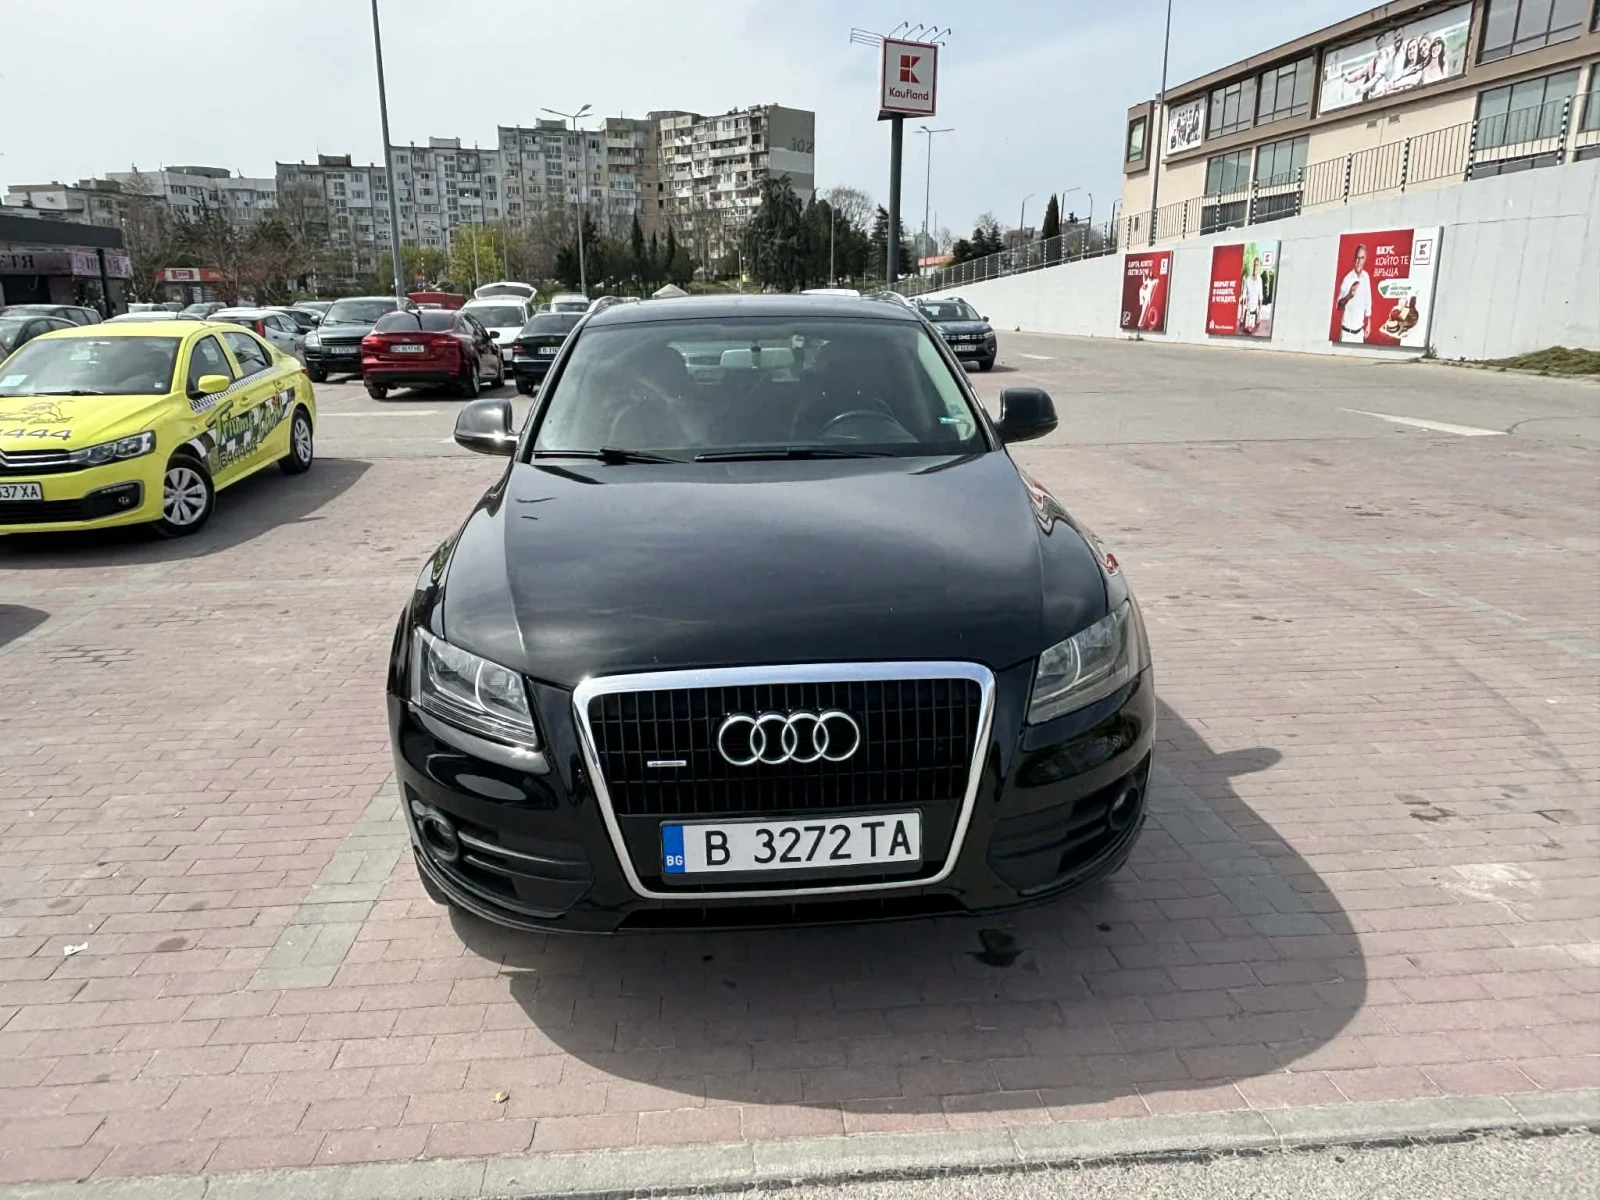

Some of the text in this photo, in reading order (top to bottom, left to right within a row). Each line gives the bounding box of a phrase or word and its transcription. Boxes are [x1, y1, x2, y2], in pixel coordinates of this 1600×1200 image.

[889, 87, 929, 101] Kaufland
[1401, 256, 1409, 265] ТЕ
[0, 429, 71, 441] 444
[705, 830, 731, 866] B
[666, 856, 683, 866] BG
